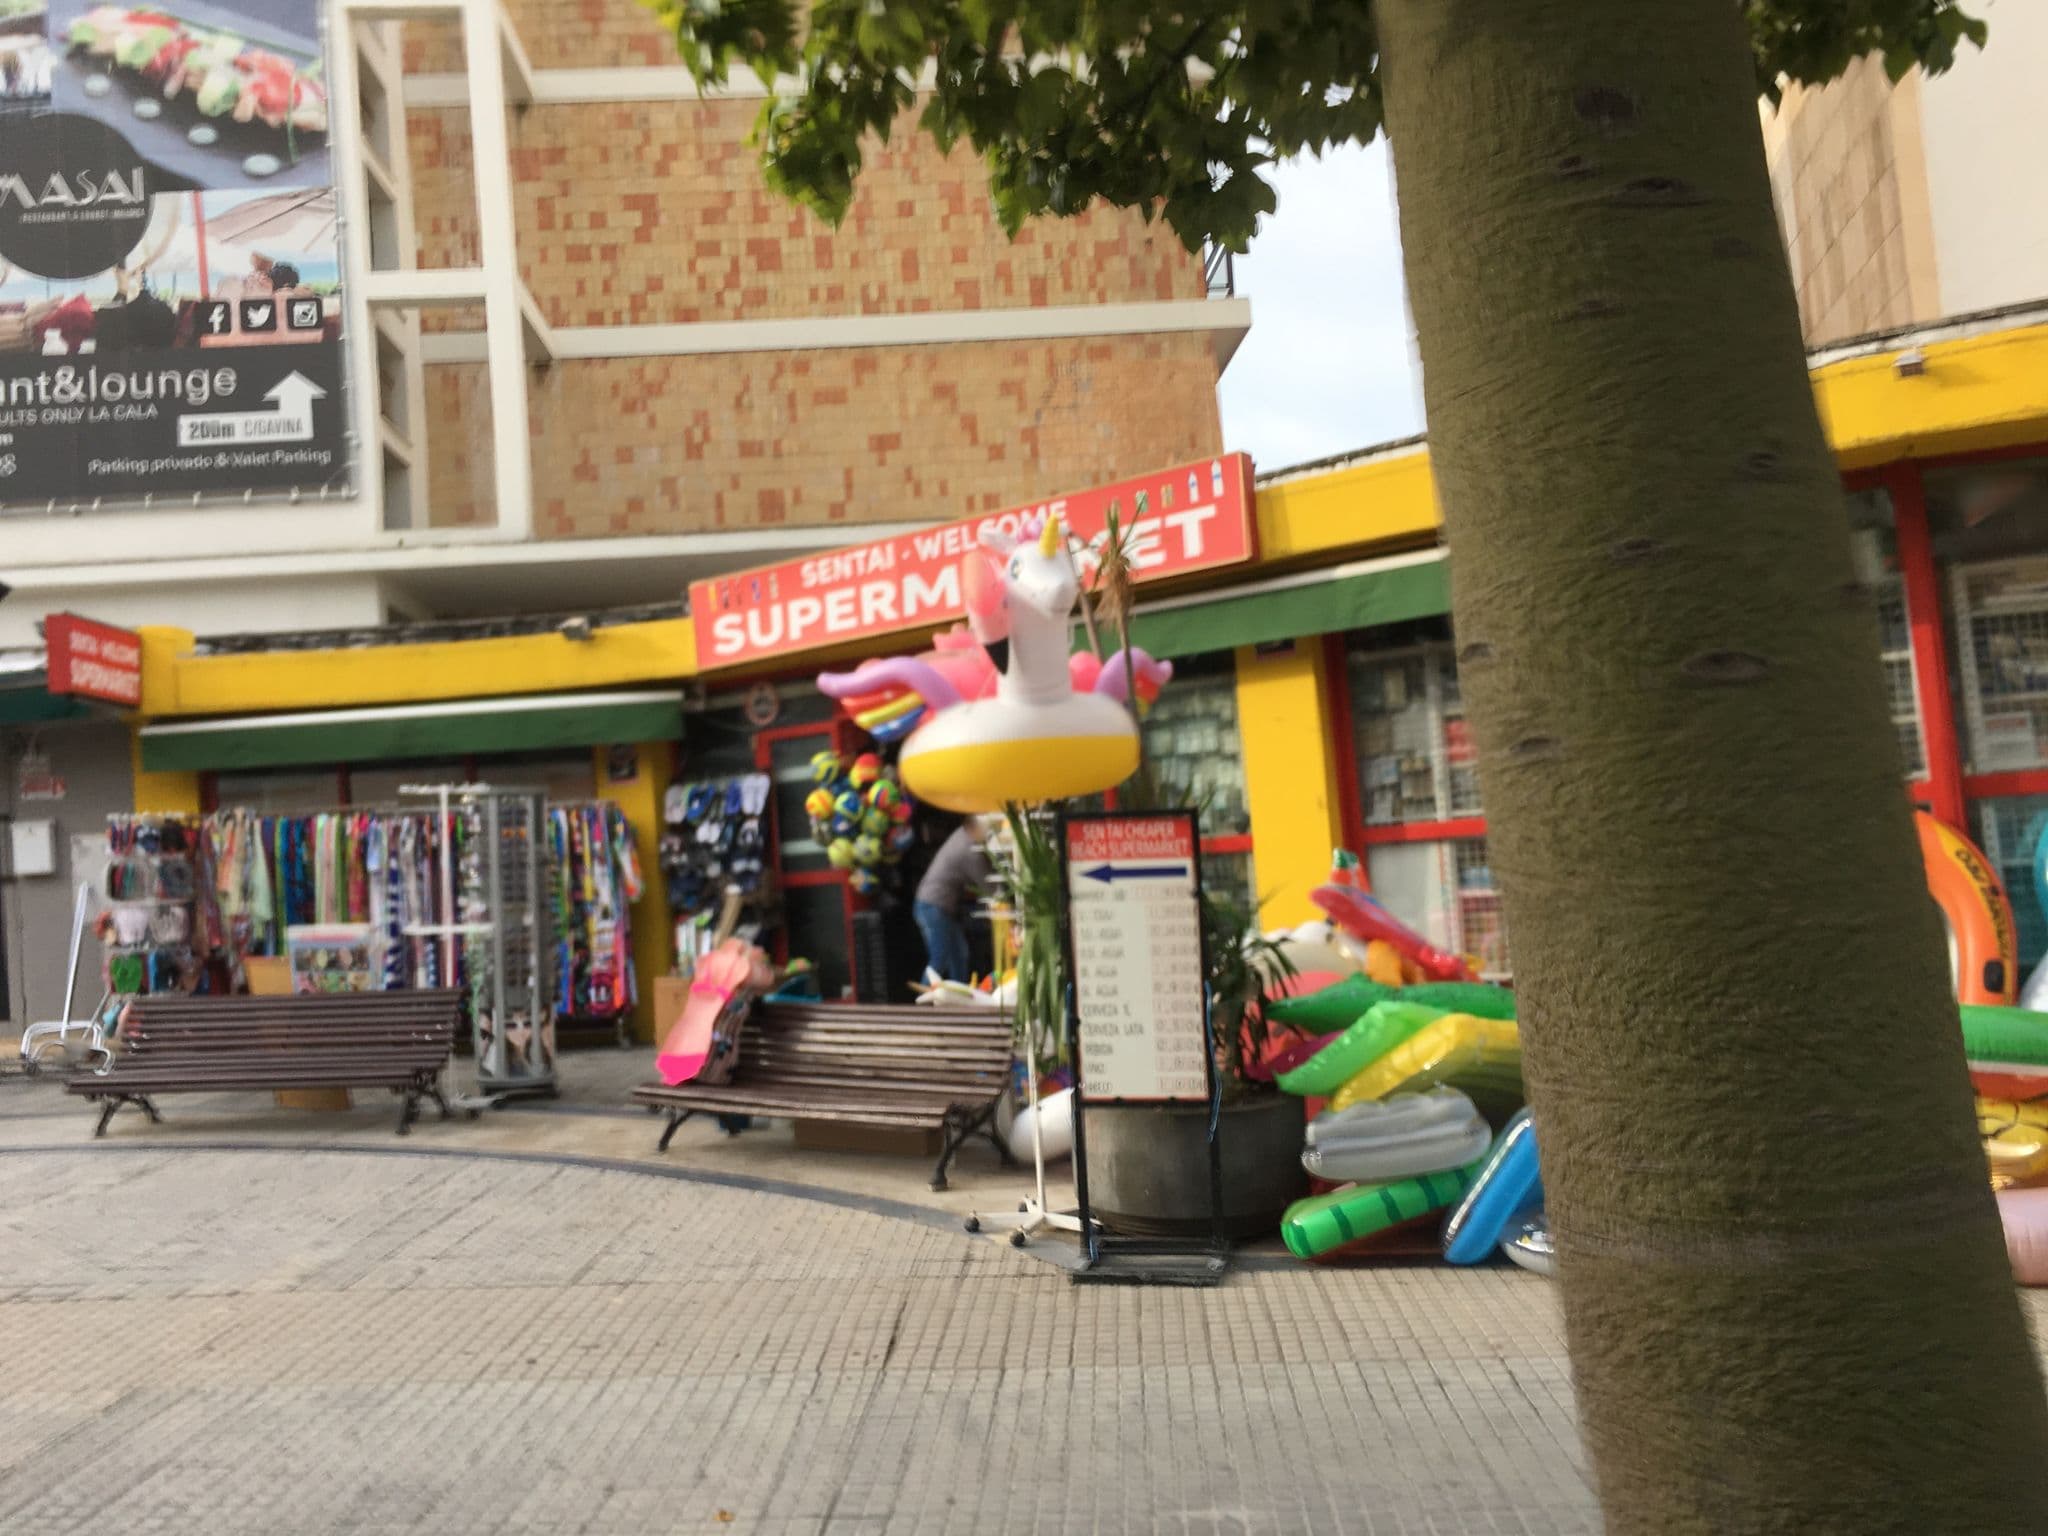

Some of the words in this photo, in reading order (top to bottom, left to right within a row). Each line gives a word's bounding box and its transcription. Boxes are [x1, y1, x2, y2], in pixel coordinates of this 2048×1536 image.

[0, 364, 238, 407] nt&lounge
[42, 406, 85, 425] ONLY
[89, 405, 109, 422] LA
[114, 403, 158, 421] CALA
[189, 419, 236, 440] 200m
[88, 457, 149, 476] Parking
[150, 454, 212, 474] privado
[214, 452, 229, 468] &
[232, 450, 272, 467] Valet
[273, 449, 331, 466] Parking
[801, 542, 896, 588] SENTAI
